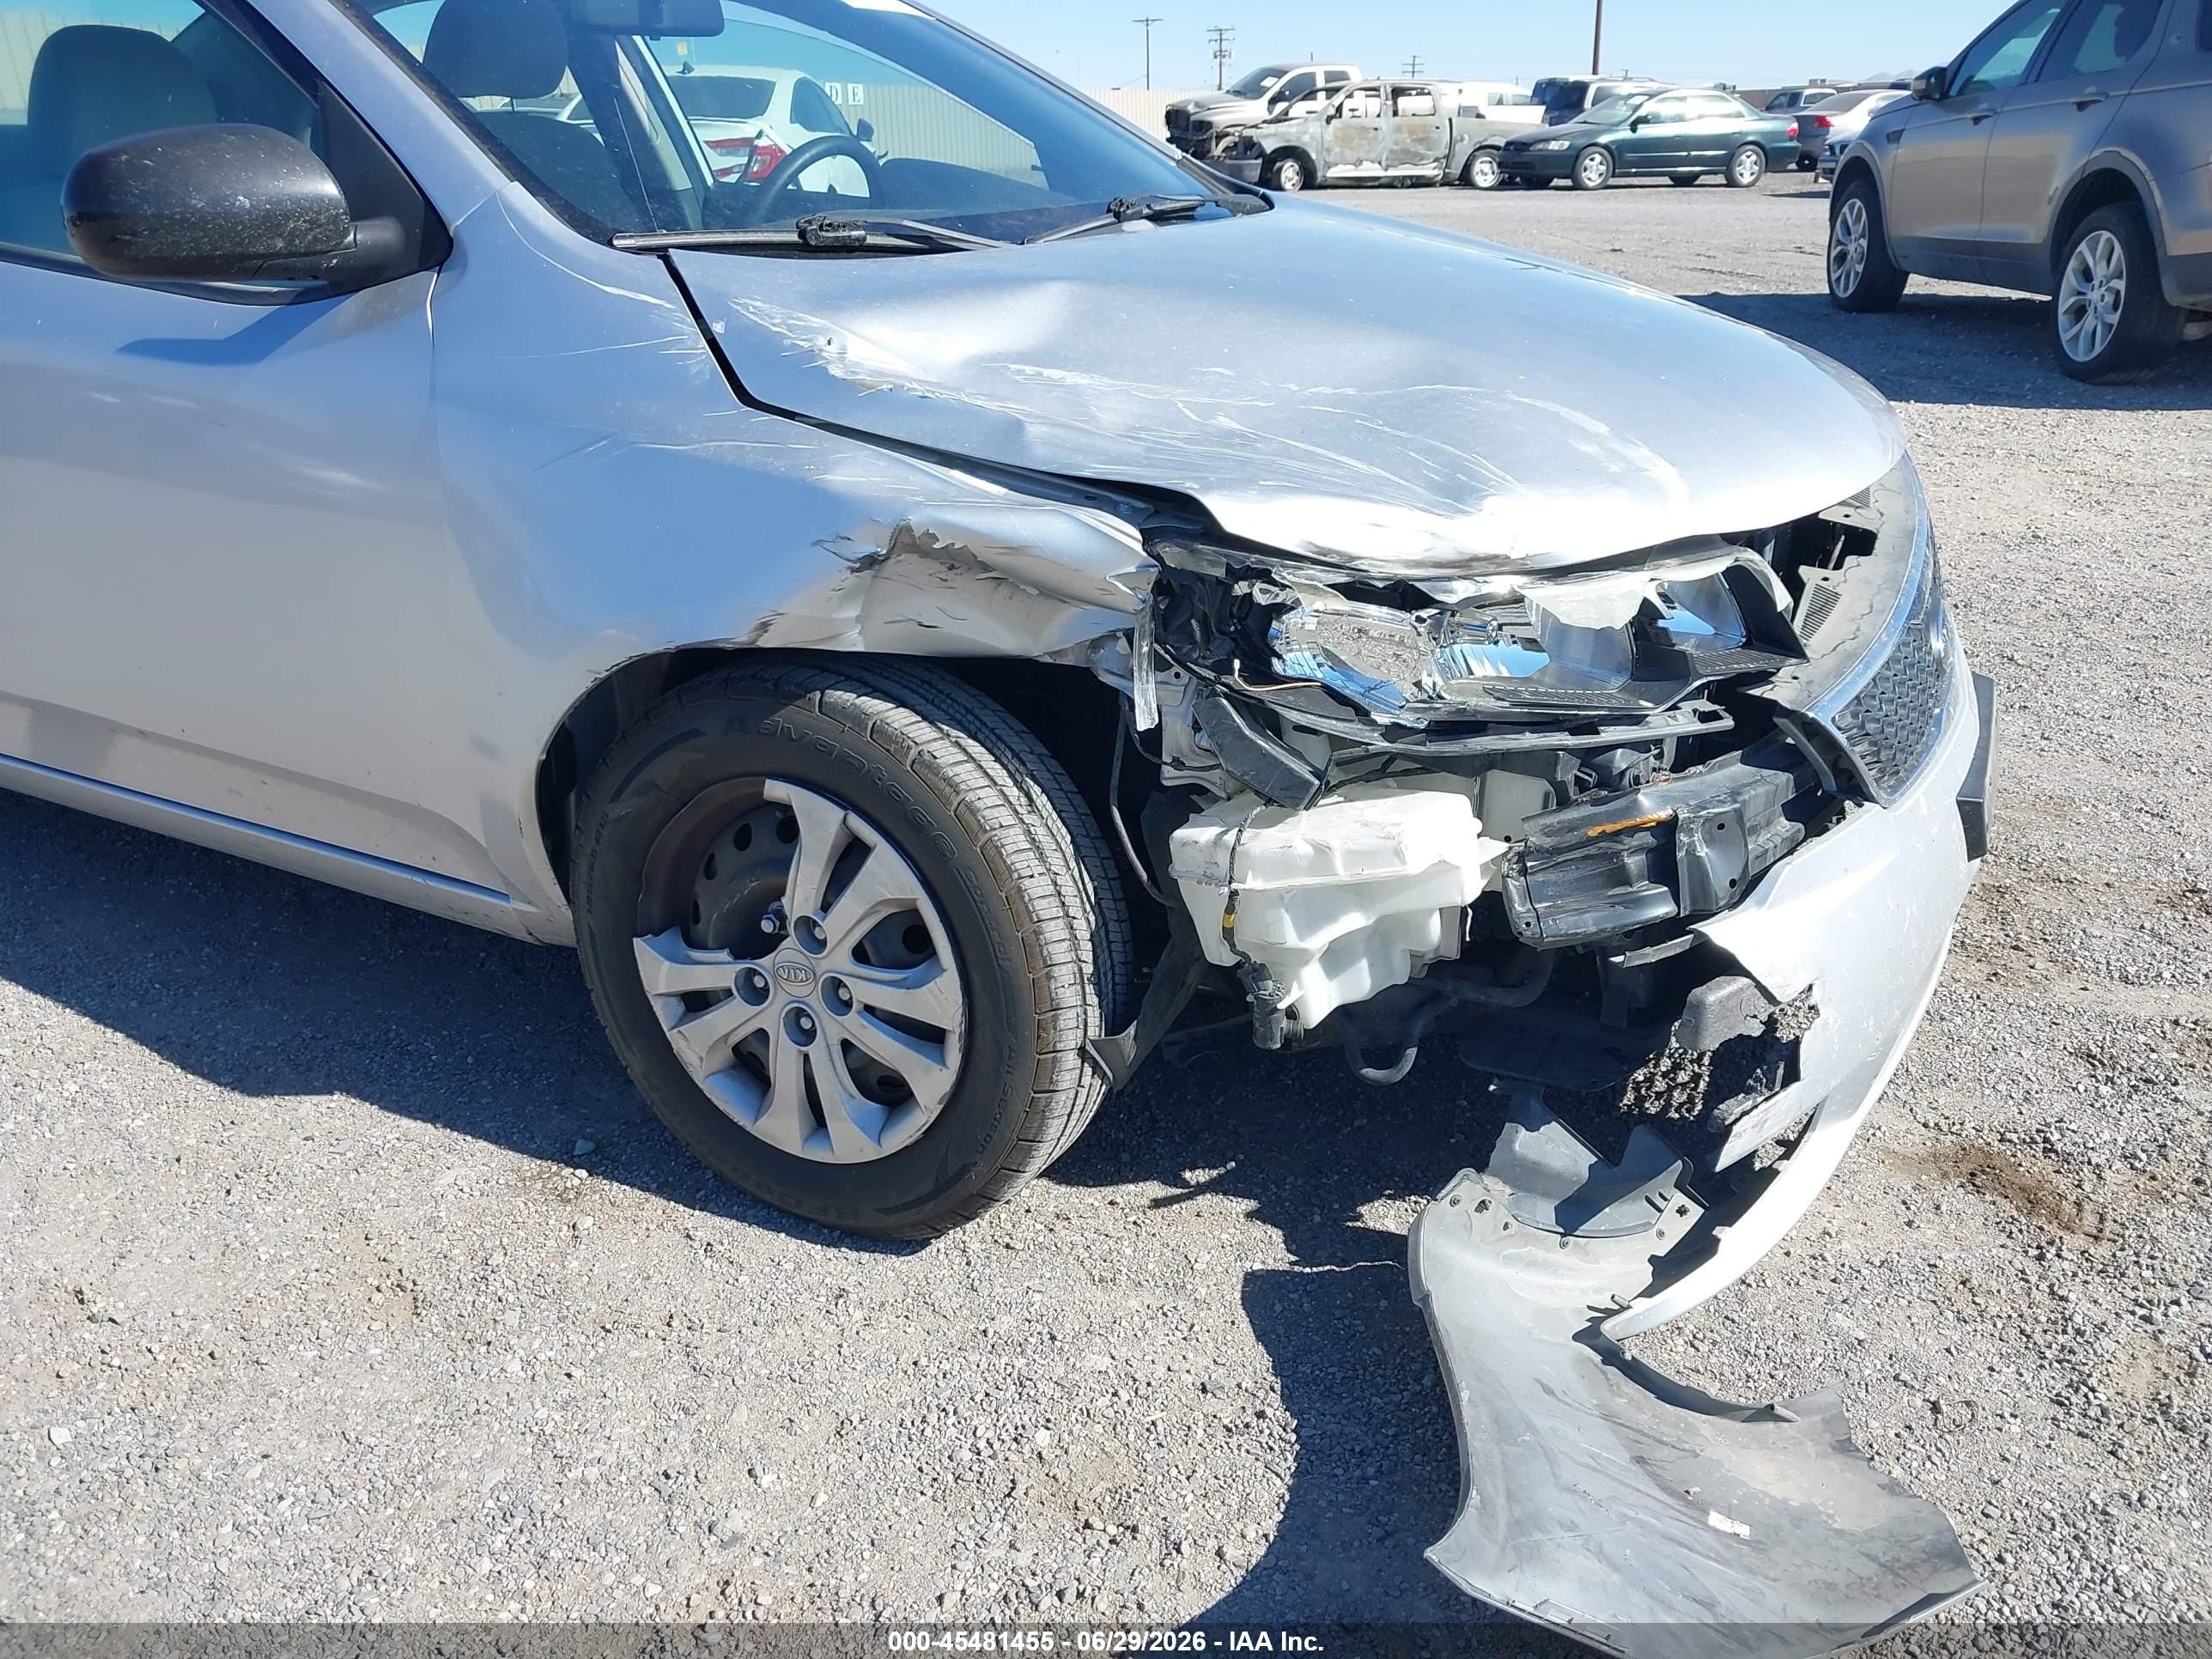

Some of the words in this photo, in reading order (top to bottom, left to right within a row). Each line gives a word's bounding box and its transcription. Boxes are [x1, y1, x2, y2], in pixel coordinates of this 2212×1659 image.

[852, 85, 861, 102] E
[721, 714, 958, 860] Advantage
[778, 965, 807, 982] KIA
